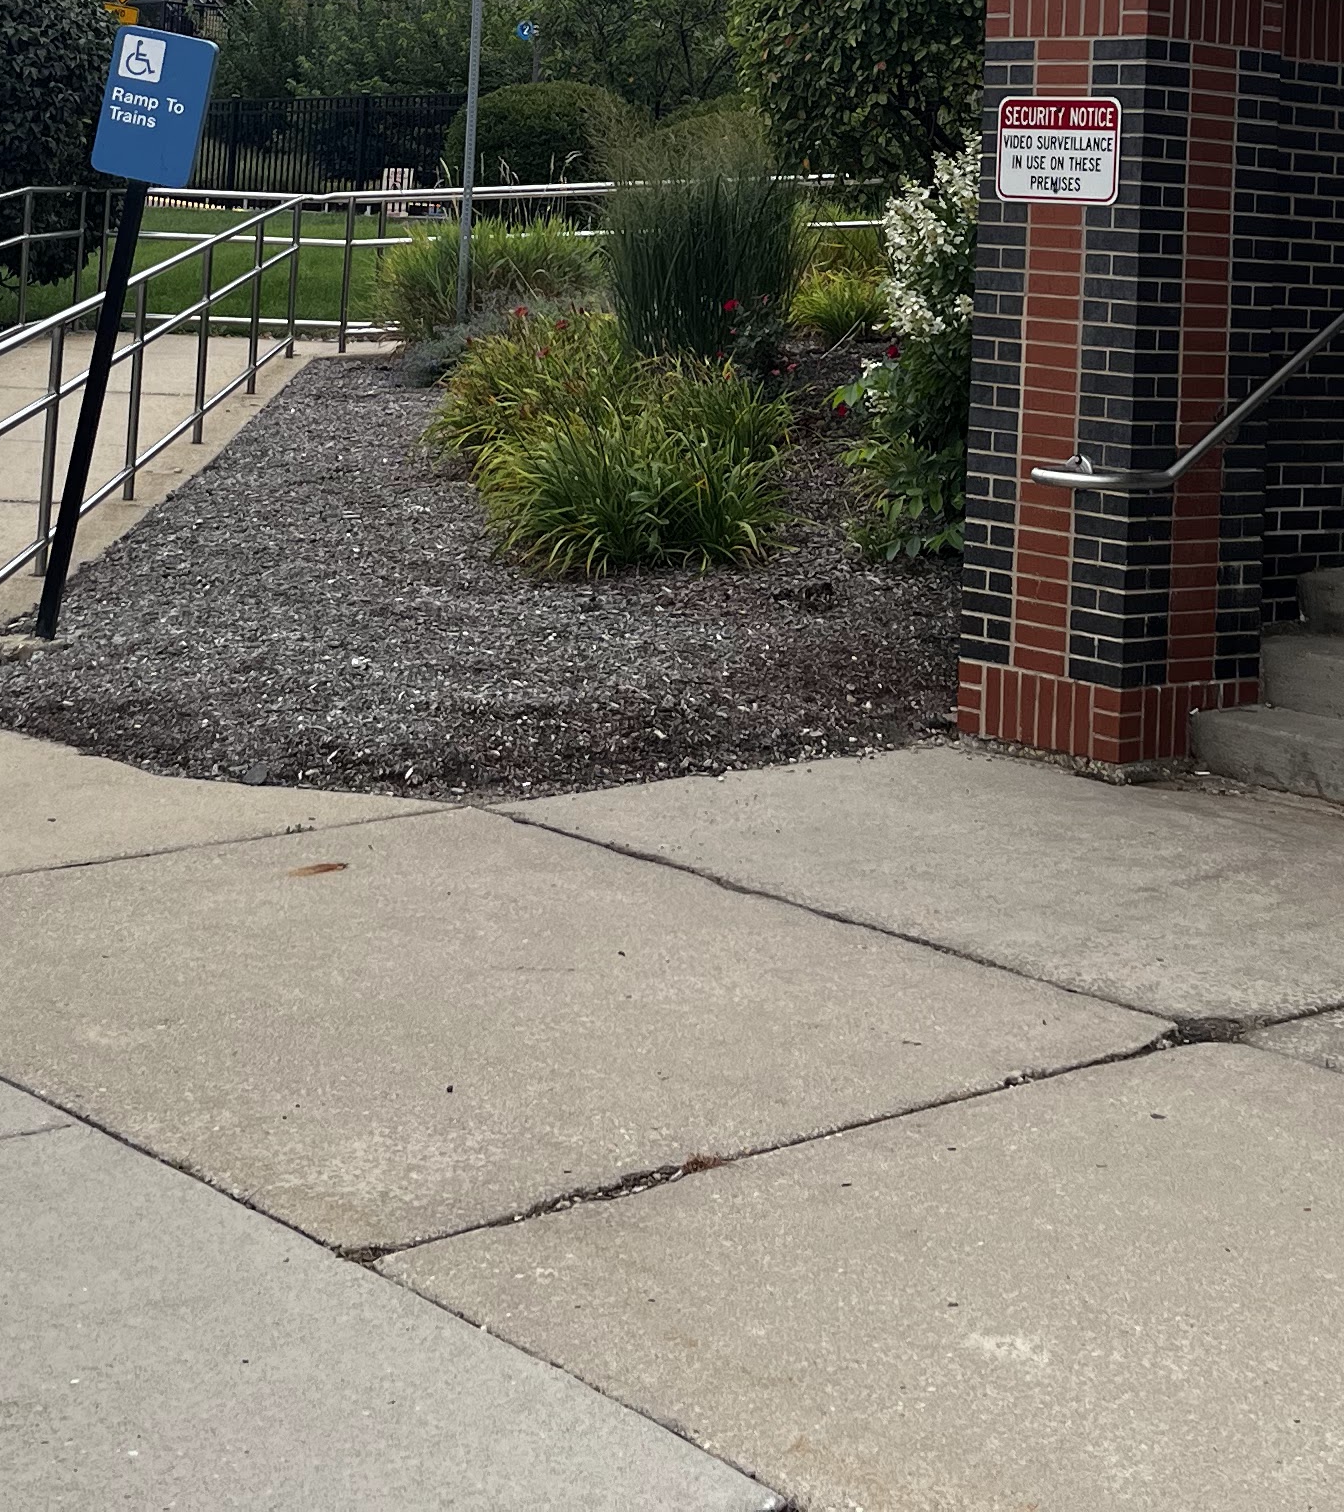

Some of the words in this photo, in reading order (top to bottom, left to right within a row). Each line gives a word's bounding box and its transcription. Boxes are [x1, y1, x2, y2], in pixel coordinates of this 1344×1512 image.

[112, 87, 159, 110] Ramp
[166, 98, 185, 115] To
[109, 106, 157, 128] Trains
[1004, 106, 1065, 127] SECURITY
[1069, 107, 1115, 127] NOTICE
[1003, 135, 1033, 150] VIDEO
[1036, 136, 1114, 152] SURVEILLANCE
[1012, 155, 1022, 170] IN
[1026, 156, 1047, 171] USE
[1050, 156, 1065, 171] ON
[1069, 157, 1102, 172] THESE
[1030, 175, 1081, 192] PREMISES
